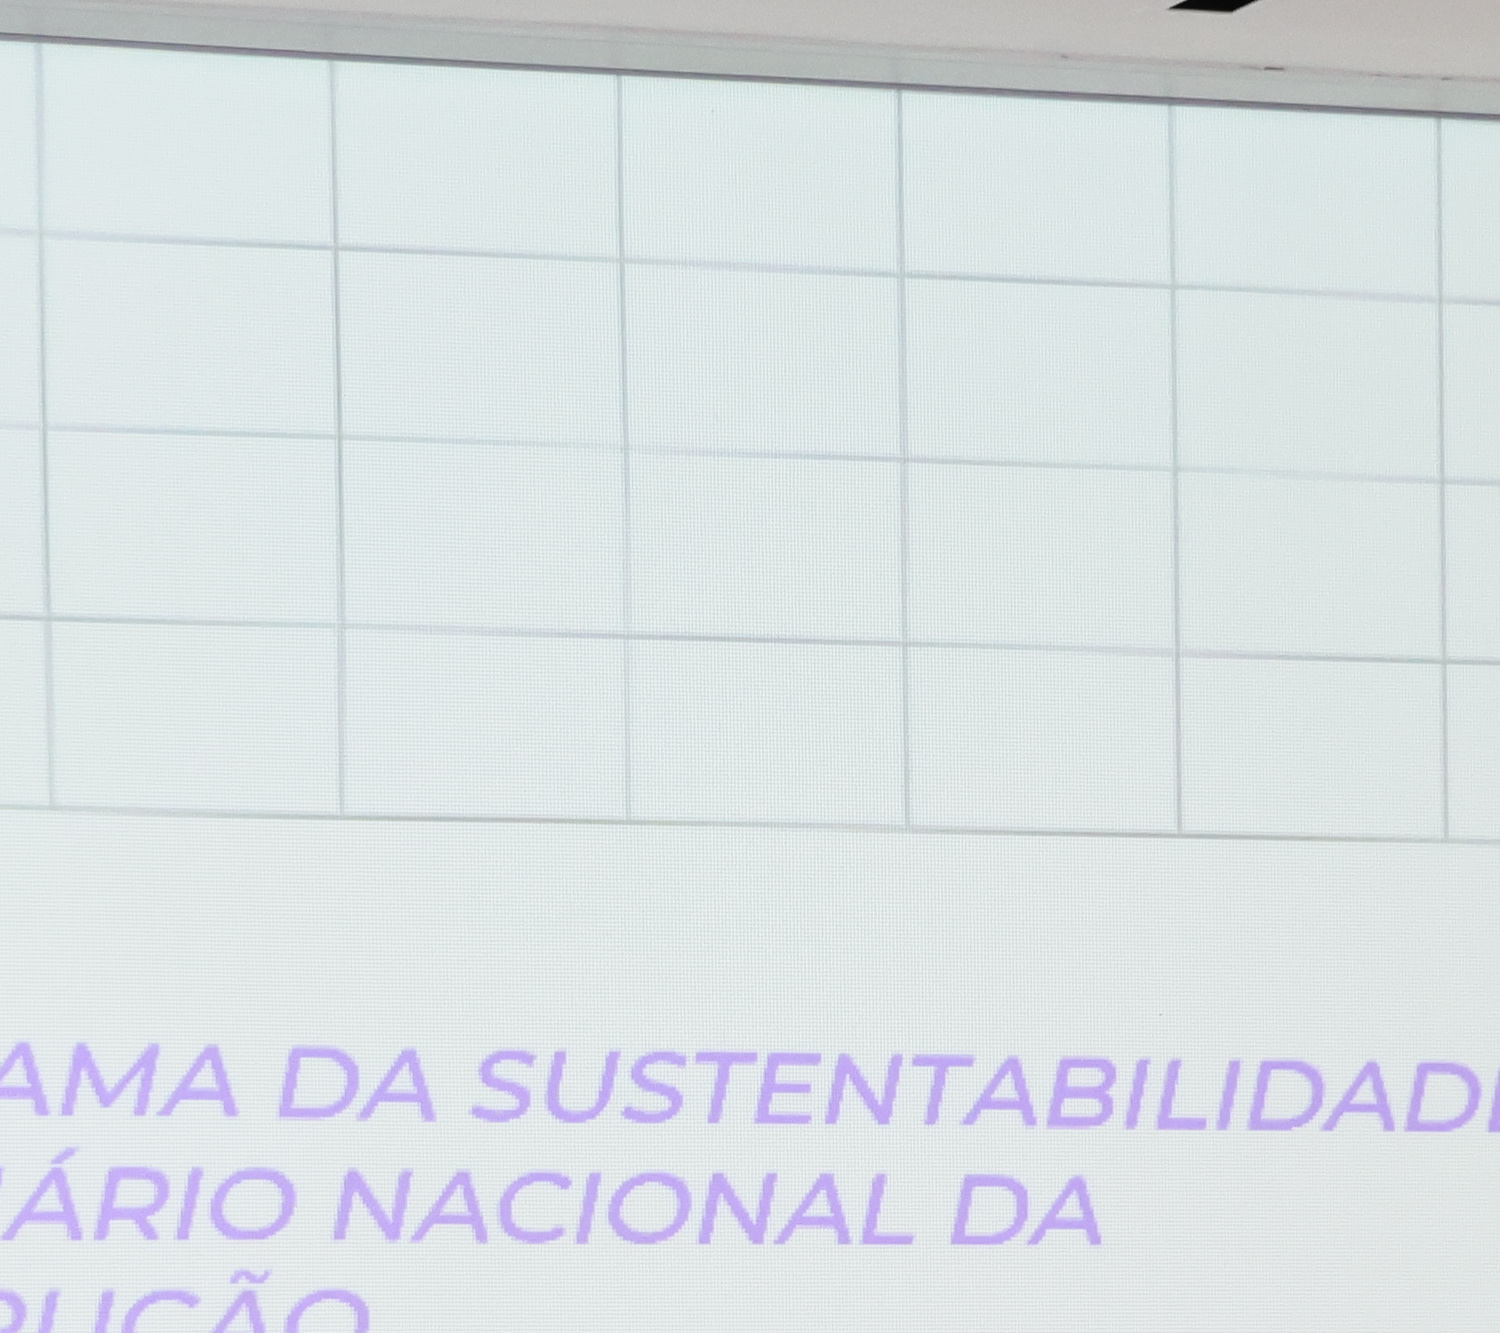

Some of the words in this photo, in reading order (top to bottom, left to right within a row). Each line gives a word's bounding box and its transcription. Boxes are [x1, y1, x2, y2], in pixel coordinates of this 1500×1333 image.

[276, 1044, 438, 1123] DA
[332, 1167, 916, 1246] NACIONAL
[950, 1172, 1104, 1247] DA
